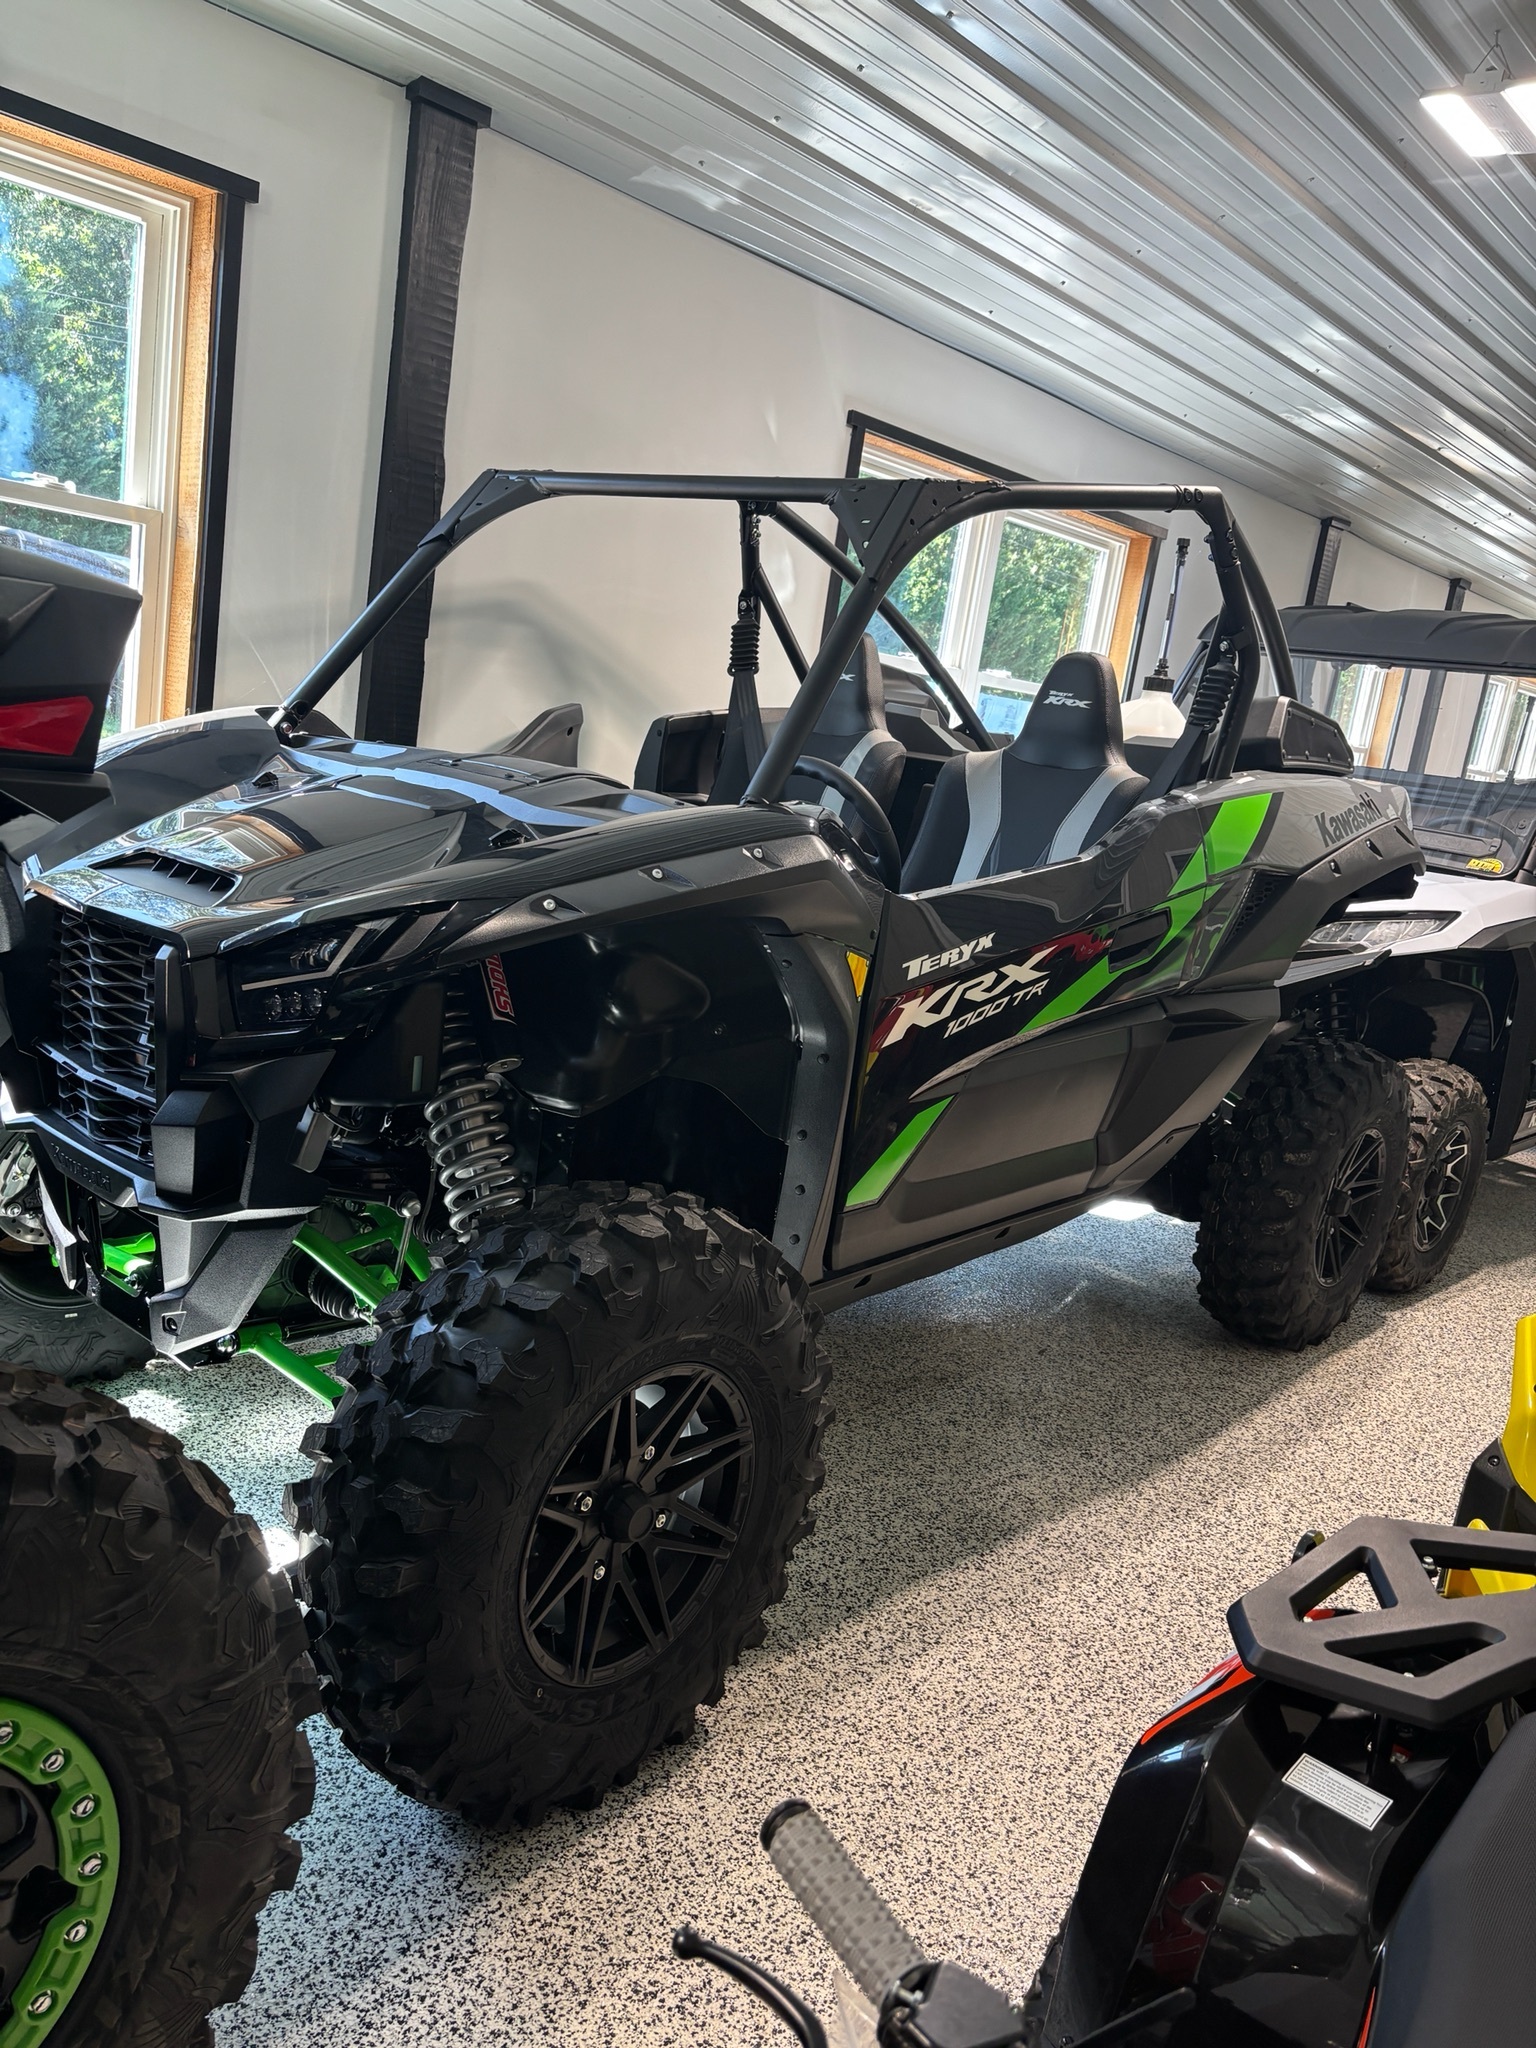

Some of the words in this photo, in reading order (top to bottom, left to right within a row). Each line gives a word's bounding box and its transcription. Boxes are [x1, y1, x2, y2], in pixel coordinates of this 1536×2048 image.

[1043, 696, 1093, 709] KRX
[1314, 792, 1383, 849] Kawasaki
[902, 932, 996, 981] TERYX
[881, 945, 1058, 1049] KRX
[943, 995, 1011, 1040] 1000
[1012, 978, 1051, 1007] TR
